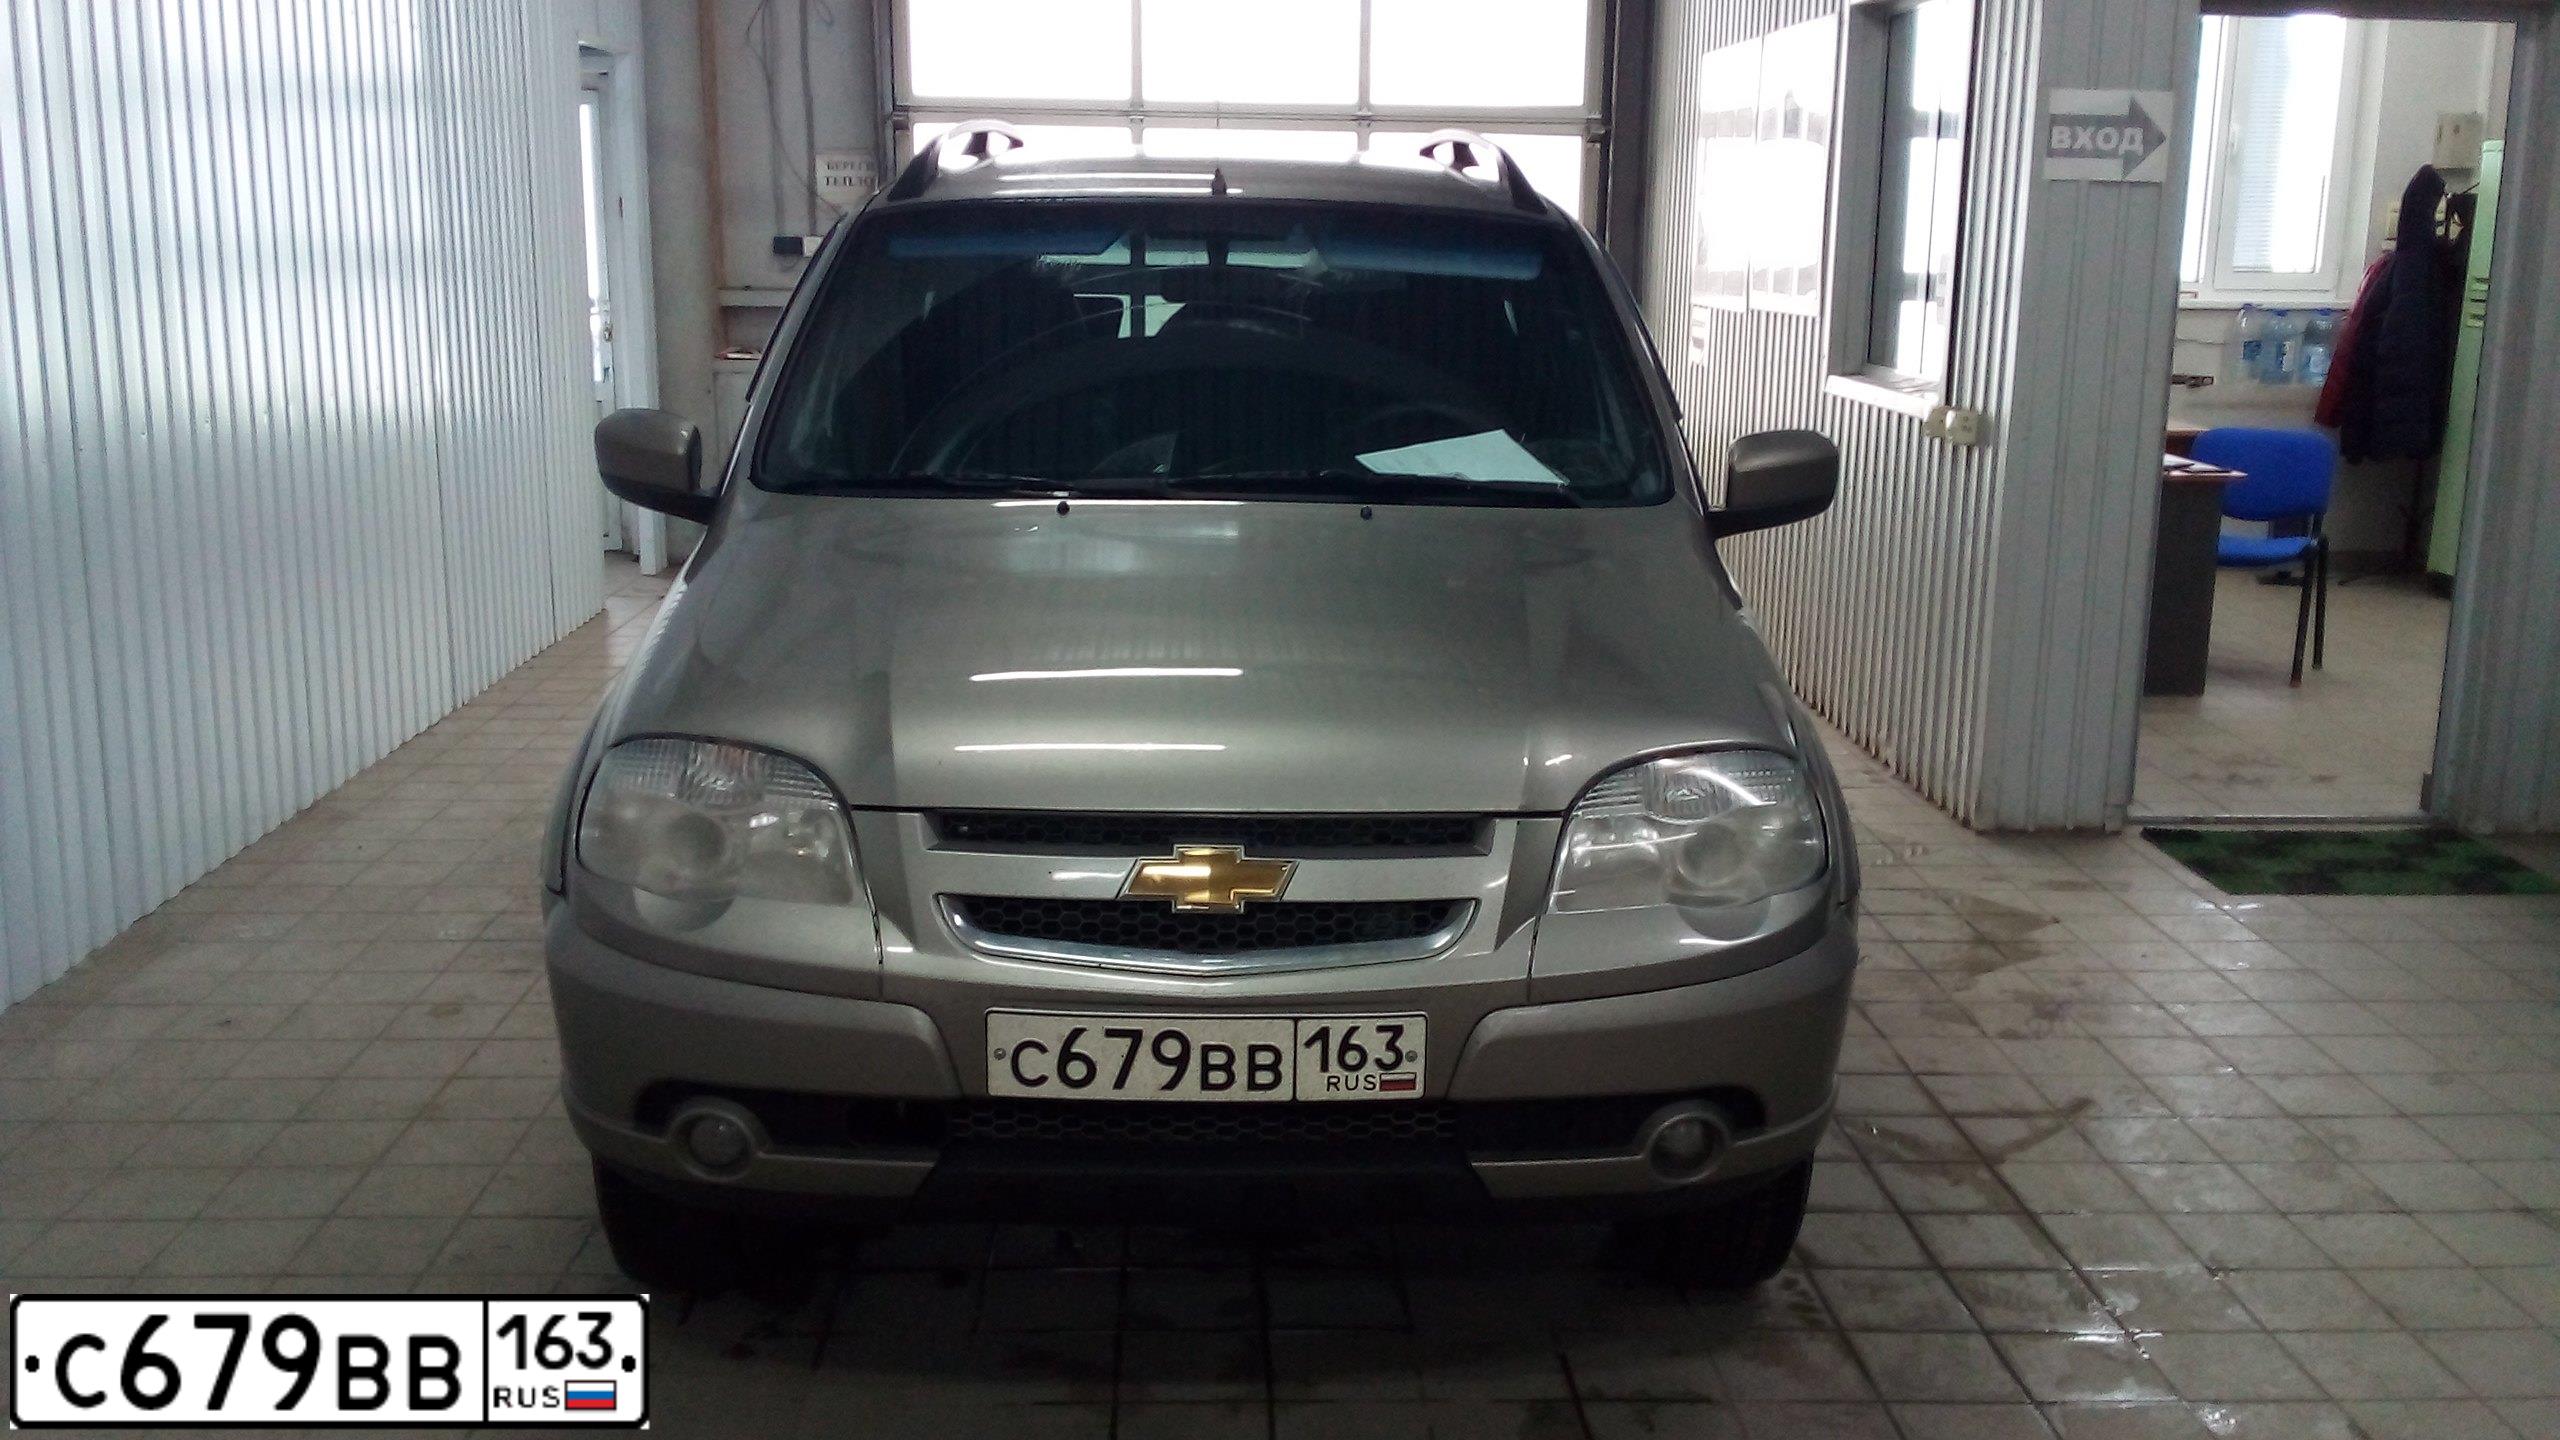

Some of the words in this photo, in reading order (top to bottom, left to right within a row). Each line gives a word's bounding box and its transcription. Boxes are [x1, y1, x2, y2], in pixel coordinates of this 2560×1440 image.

[2051, 125, 2144, 156] ВХОД
[1304, 1024, 1405, 1073] 163
[1326, 1075, 1377, 1092] RUS
